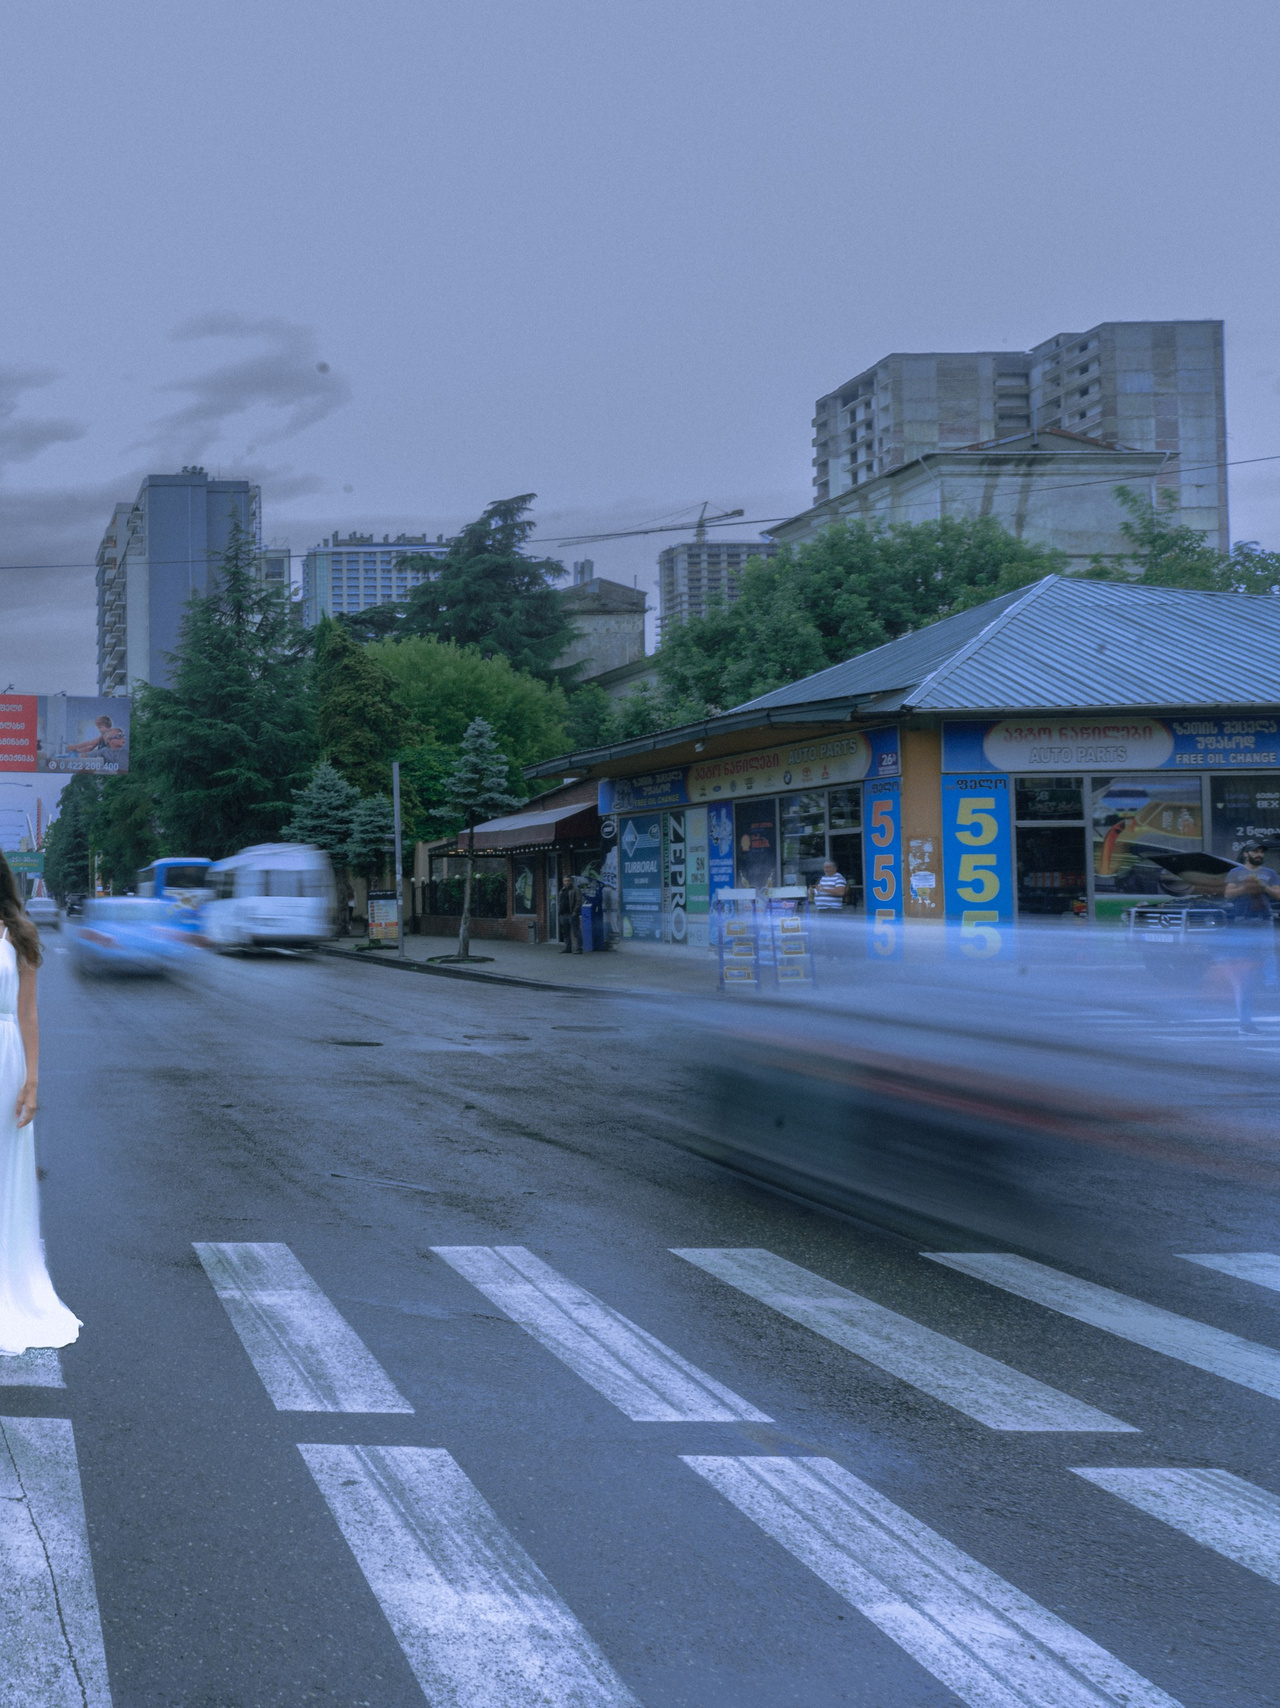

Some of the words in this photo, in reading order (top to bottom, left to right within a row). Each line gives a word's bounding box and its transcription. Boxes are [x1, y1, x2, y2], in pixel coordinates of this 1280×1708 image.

[1004, 727, 1052, 742] ავტო
[1059, 725, 1154, 742] ნაწილები
[724, 753, 779, 775] ნაწილები
[788, 748, 816, 765] AUTO
[819, 739, 857, 759] PARTS
[1029, 747, 1072, 763] AUTO
[1076, 746, 1127, 762] PARTS
[1176, 753, 1204, 765] FREE
[1207, 753, 1226, 764] OIL
[1229, 752, 1277, 763] CHANGE
[59, 762, 65, 770] 0
[67, 762, 83, 770] 422
[85, 762, 101, 770] 200
[103, 762, 119, 771] 400
[871, 800, 894, 847] 5
[955, 797, 999, 846] 5
[1236, 826, 1245, 836] 2
[624, 861, 658, 873] TURBORAL
[670, 815, 687, 940] ZEPRO
[873, 854, 896, 901] 5
[956, 854, 1000, 902] 5
[874, 909, 896, 956] 5
[960, 911, 1002, 957] 5
